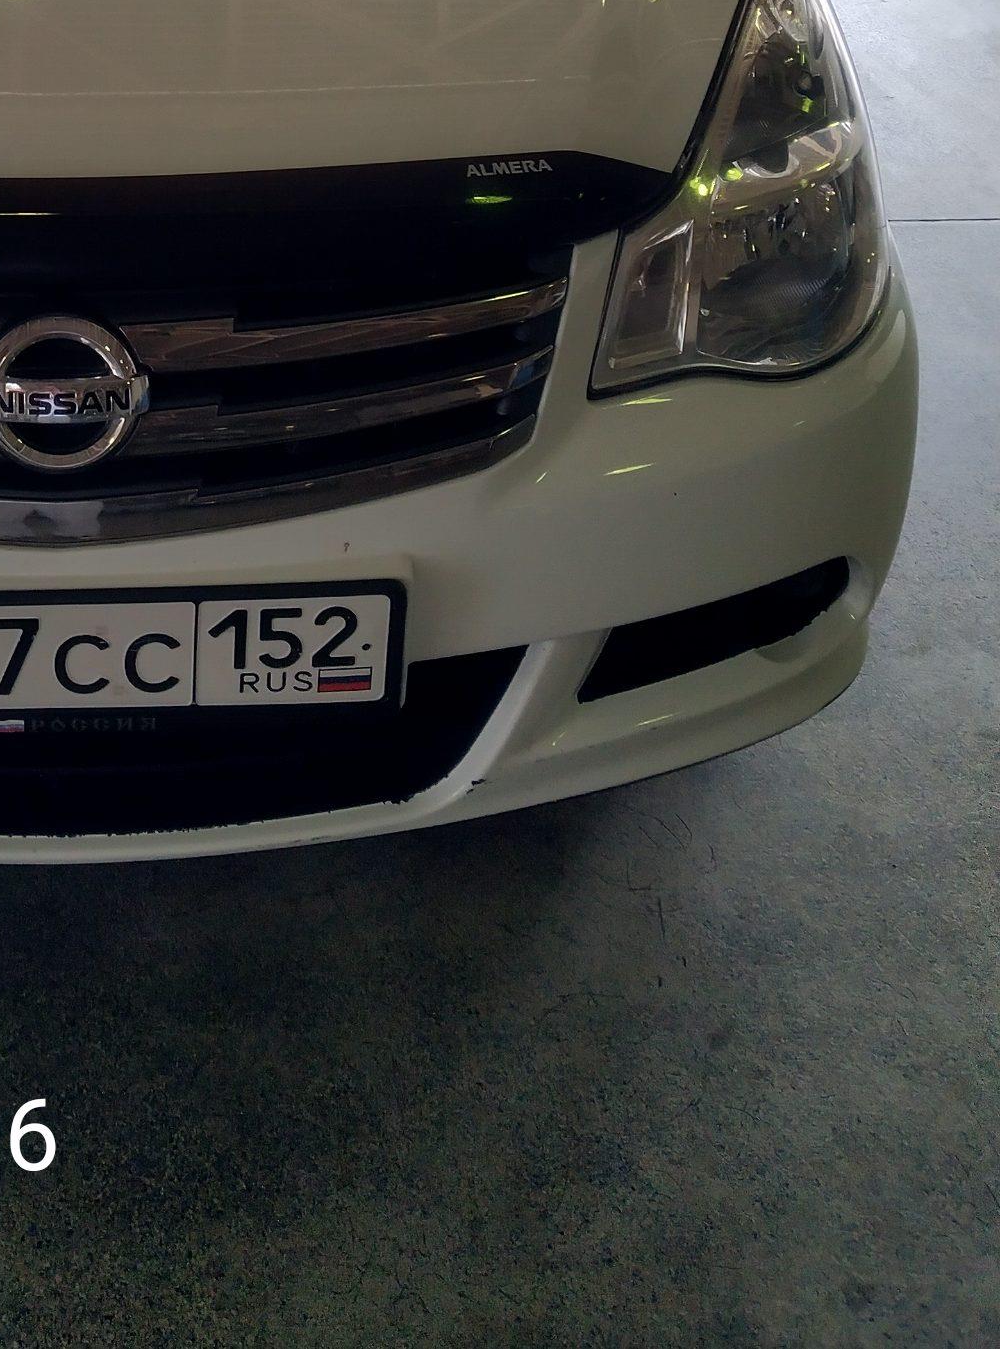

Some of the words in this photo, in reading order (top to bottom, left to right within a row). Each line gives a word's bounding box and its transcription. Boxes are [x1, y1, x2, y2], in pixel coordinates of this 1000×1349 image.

[466, 159, 553, 178] ALMERA
[207, 605, 358, 670] 152
[239, 670, 313, 694] RUS
